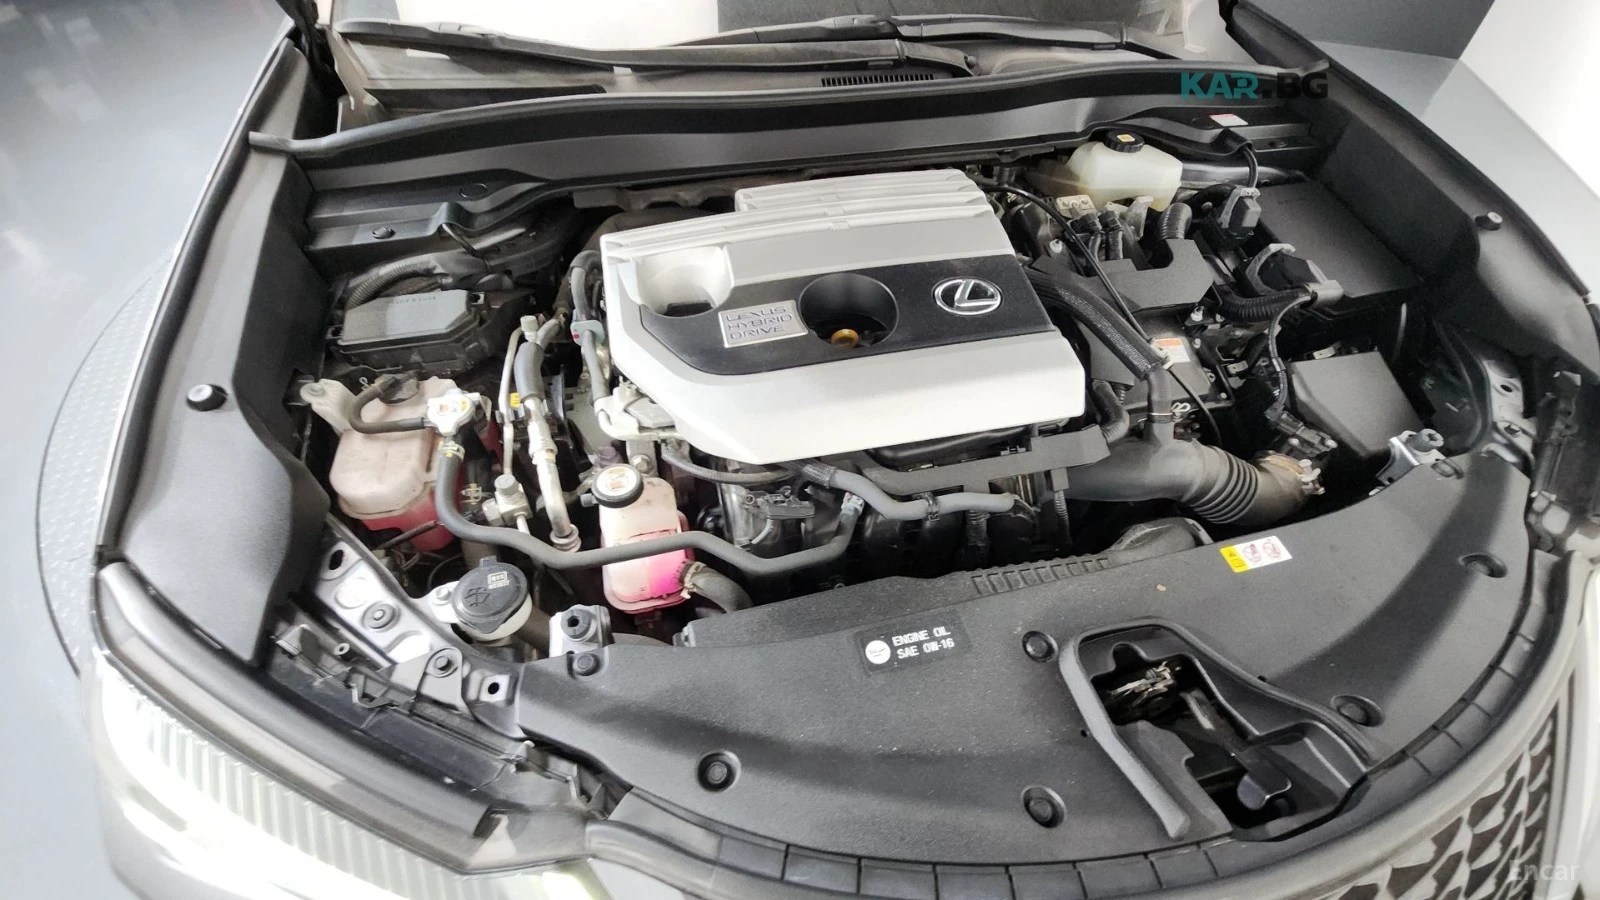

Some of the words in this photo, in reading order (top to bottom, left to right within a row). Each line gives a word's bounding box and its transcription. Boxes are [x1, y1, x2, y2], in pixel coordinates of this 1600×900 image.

[726, 307, 787, 322] LEXUS
[728, 314, 793, 331] HYBRID
[730, 326, 784, 340] DRIVE
[891, 630, 930, 647] ENGINE
[896, 645, 920, 659] SAE
[922, 637, 955, 653] 0W-16
